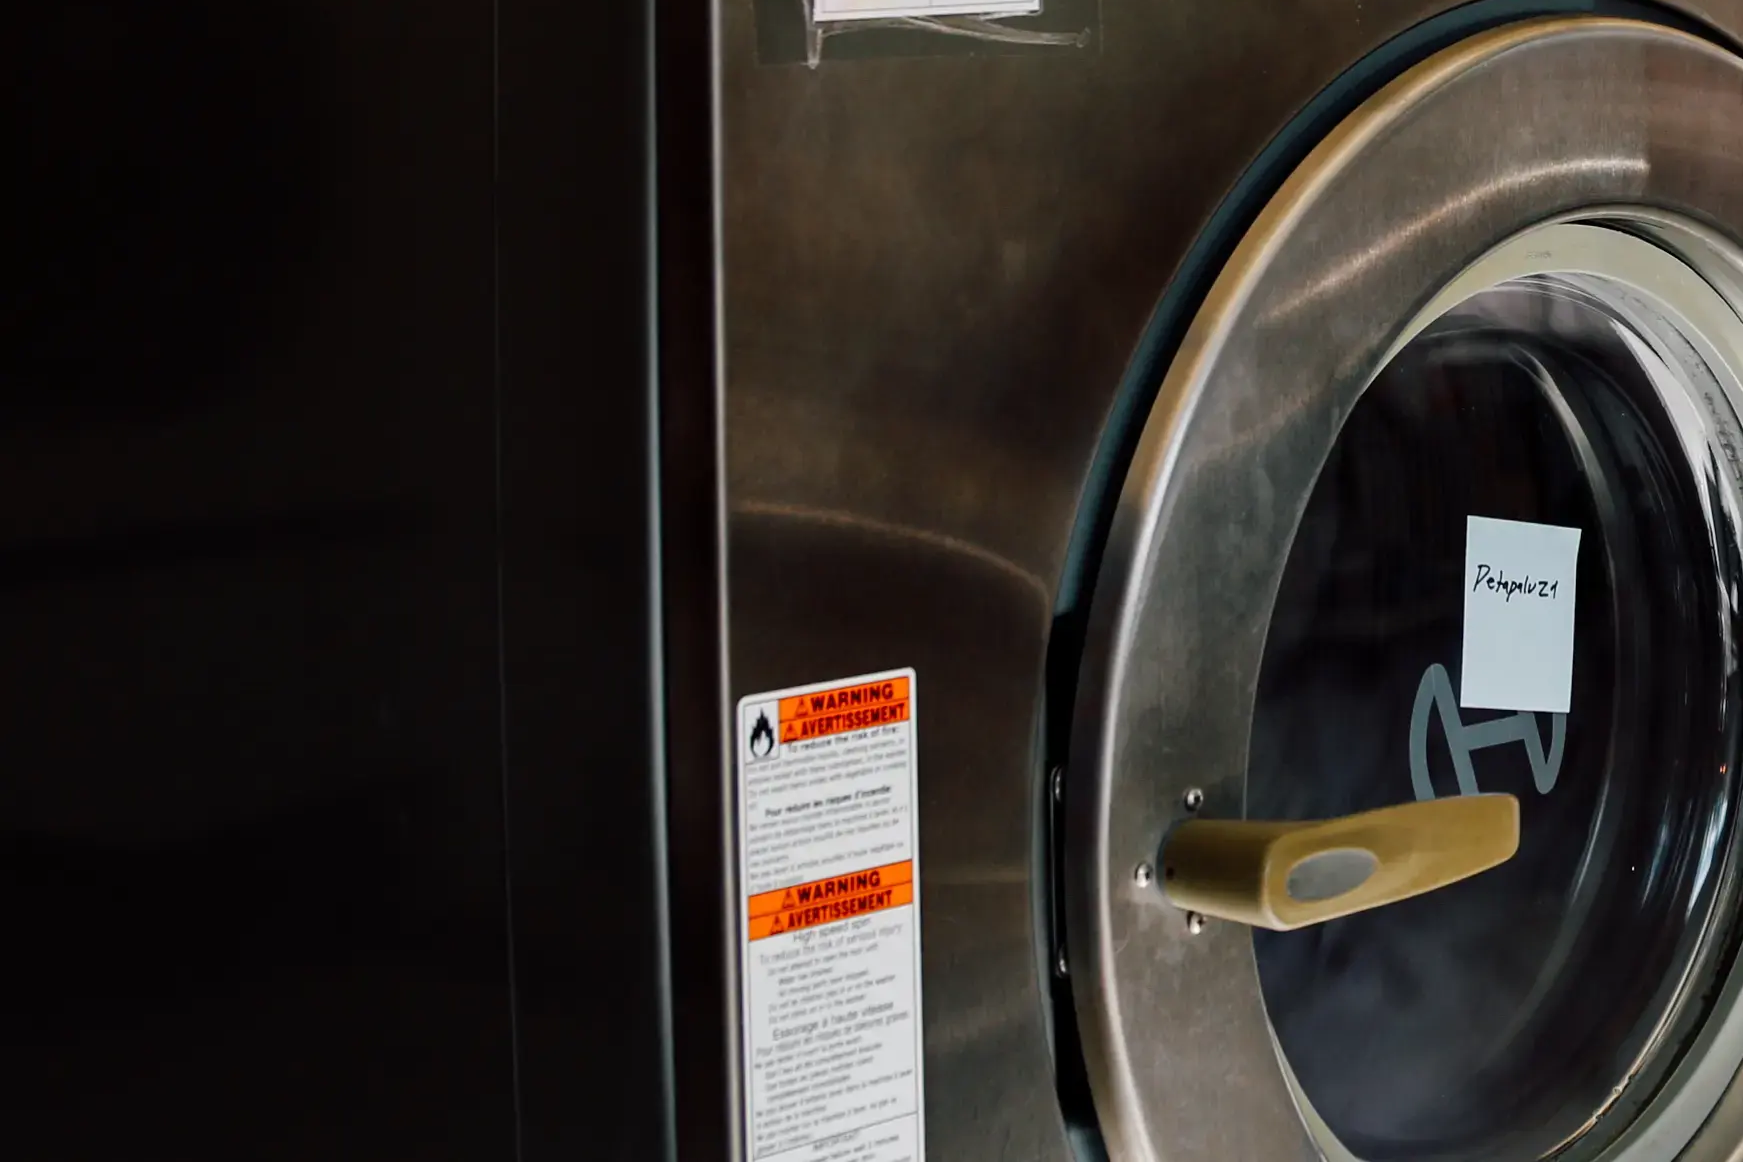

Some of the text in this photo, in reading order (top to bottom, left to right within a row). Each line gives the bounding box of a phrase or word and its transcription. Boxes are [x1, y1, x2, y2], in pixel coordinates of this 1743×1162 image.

[810, 683, 894, 714] WARNING
[802, 702, 906, 738] AVERTISSEMENT
[797, 871, 881, 903] WARNING
[787, 889, 892, 928] AVERTISSEMENT
